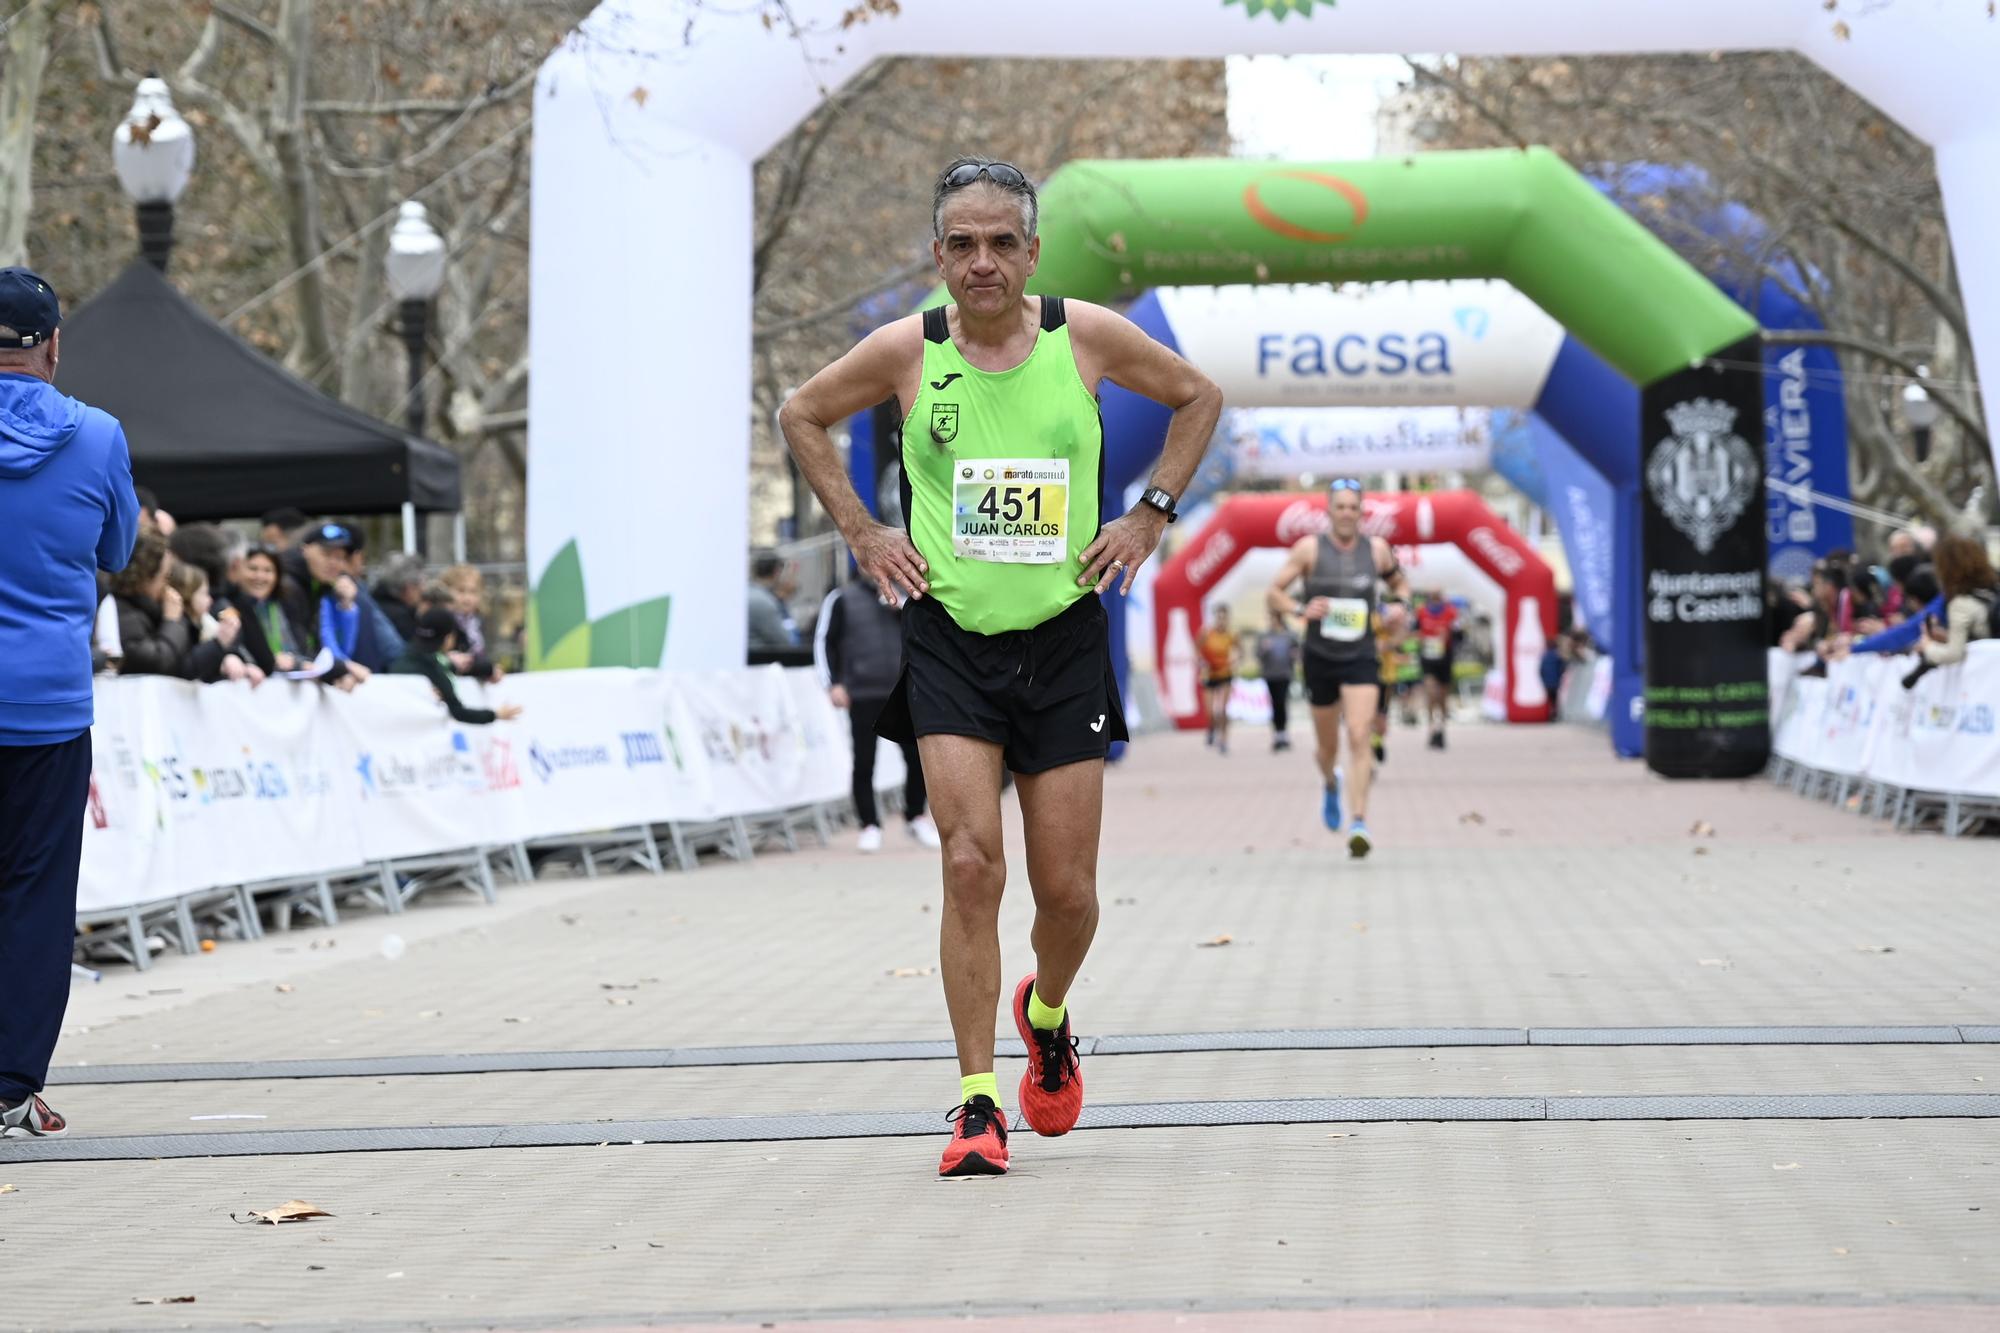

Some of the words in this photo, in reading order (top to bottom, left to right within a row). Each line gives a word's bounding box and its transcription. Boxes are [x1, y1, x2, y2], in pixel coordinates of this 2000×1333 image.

[1778, 347, 1818, 543] BAVIERA
[977, 486, 1042, 522] 451
[961, 522, 999, 535] JUAN
[1003, 523, 1059, 536] CARLOS
[1649, 569, 1762, 596] Ajuntament
[1649, 597, 1674, 622] de
